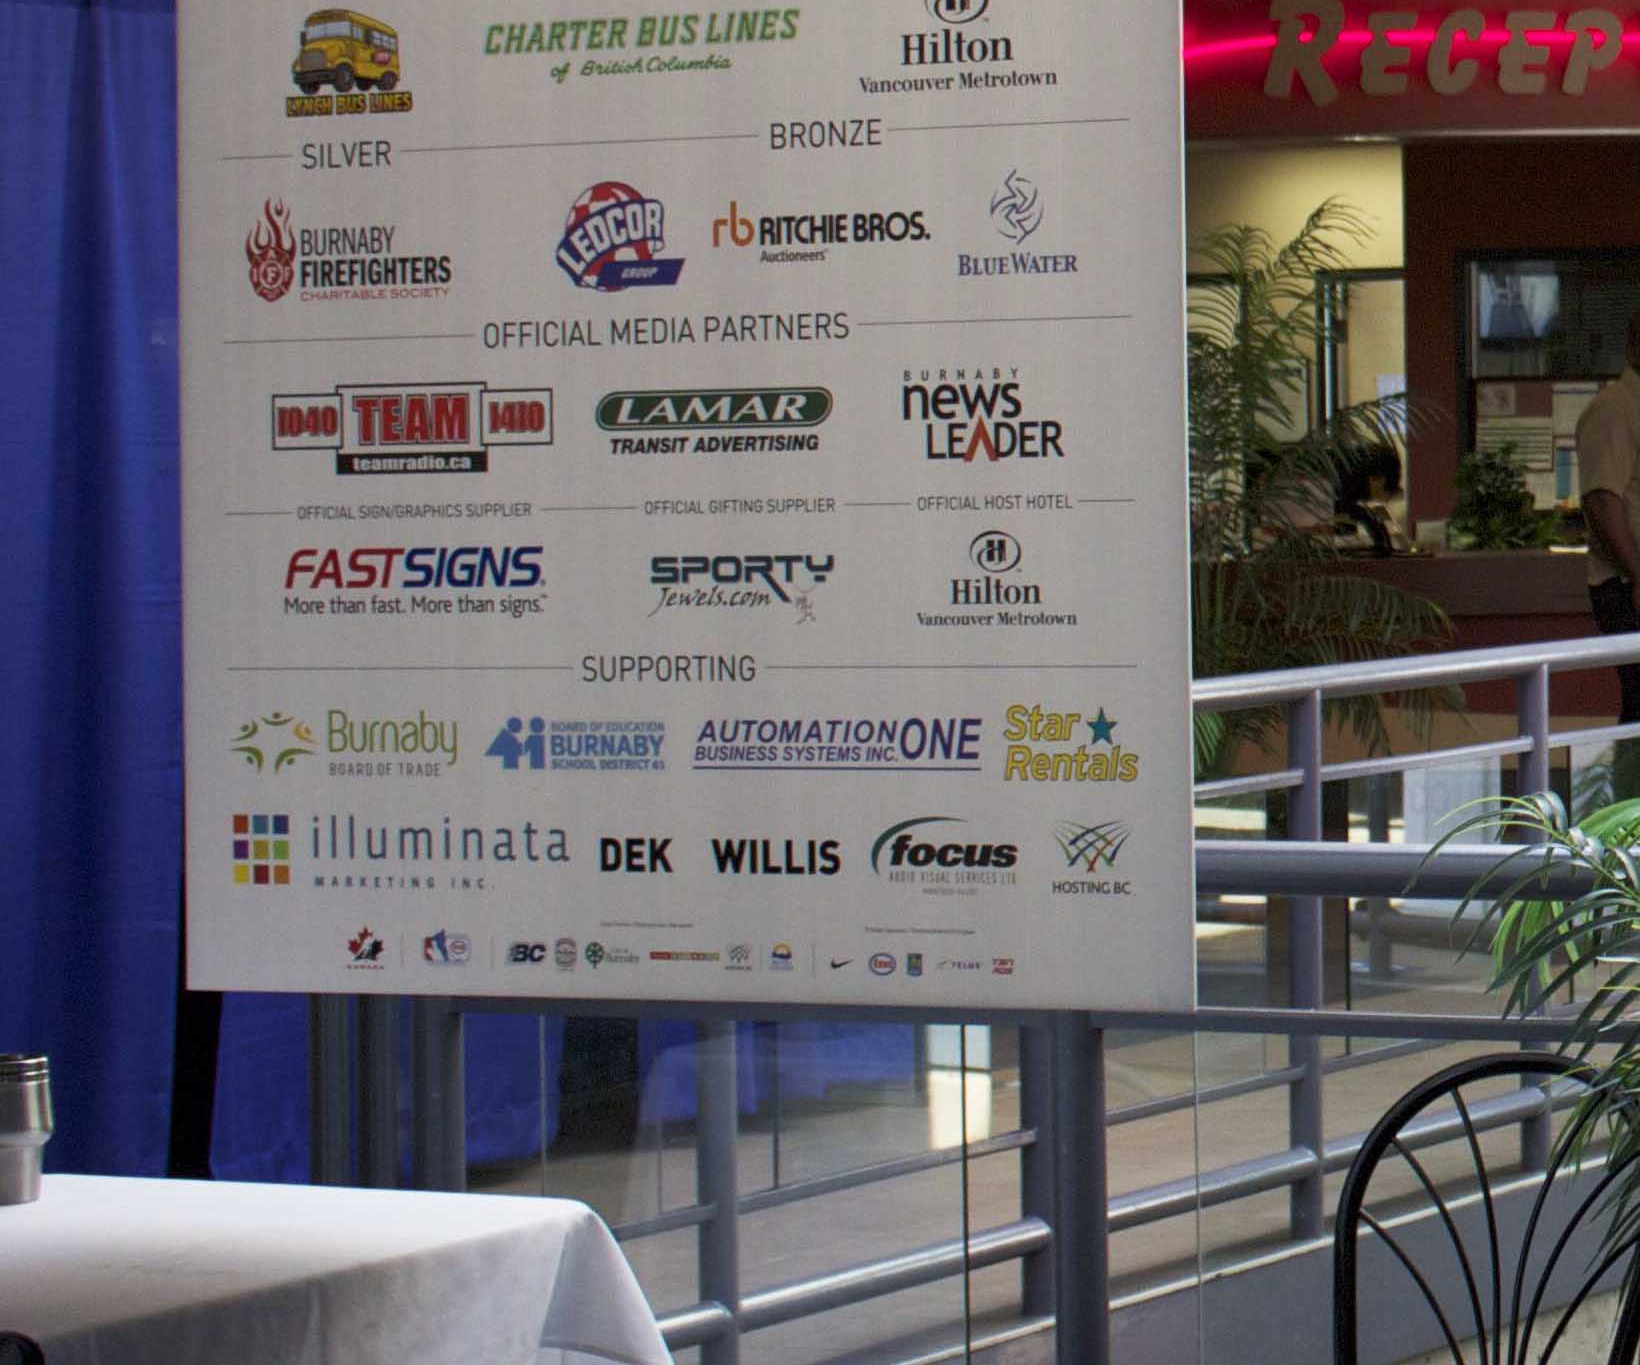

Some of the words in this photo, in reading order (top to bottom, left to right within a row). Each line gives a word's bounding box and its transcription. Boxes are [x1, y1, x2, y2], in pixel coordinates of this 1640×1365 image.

[485, 18, 628, 54] CHARTER
[636, 15, 699, 47] BUS
[706, 9, 799, 43] LINES
[903, 29, 1012, 65] Hilton
[551, 62, 570, 84] of
[580, 58, 643, 76] British
[646, 54, 731, 72] Columbia
[859, 77, 954, 93] Vancouver
[959, 71, 1057, 88] Metrotown
[770, 119, 881, 150] BRONZE
[303, 140, 391, 169] SILVER
[760, 214, 847, 245] RITCHIE
[853, 211, 930, 242] BROS.
[484, 320, 601, 349] OFFICIAL
[611, 318, 695, 345] MEDIA
[704, 312, 849, 342] PARTNERS
[352, 395, 470, 445] TEAM
[618, 395, 810, 424] LAMAR
[611, 437, 689, 454] TRANSIT
[694, 435, 818, 452] ADVERTISING
[917, 496, 980, 511] OFFICIAL
[984, 495, 1021, 510] HOST
[1026, 494, 1072, 509] HOTEL
[284, 597, 325, 614] More
[330, 596, 366, 614] than
[371, 595, 405, 614] fast.
[411, 596, 452, 613] More
[457, 595, 494, 613] than
[582, 655, 755, 682] SUPPORTING
[313, 815, 570, 862] illuminata
[891, 835, 1017, 867] focus
[601, 838, 672, 872] DEK
[712, 839, 840, 875] WILLIS
[1053, 881, 1110, 894] HOSTING
[1111, 880, 1133, 896] BC
